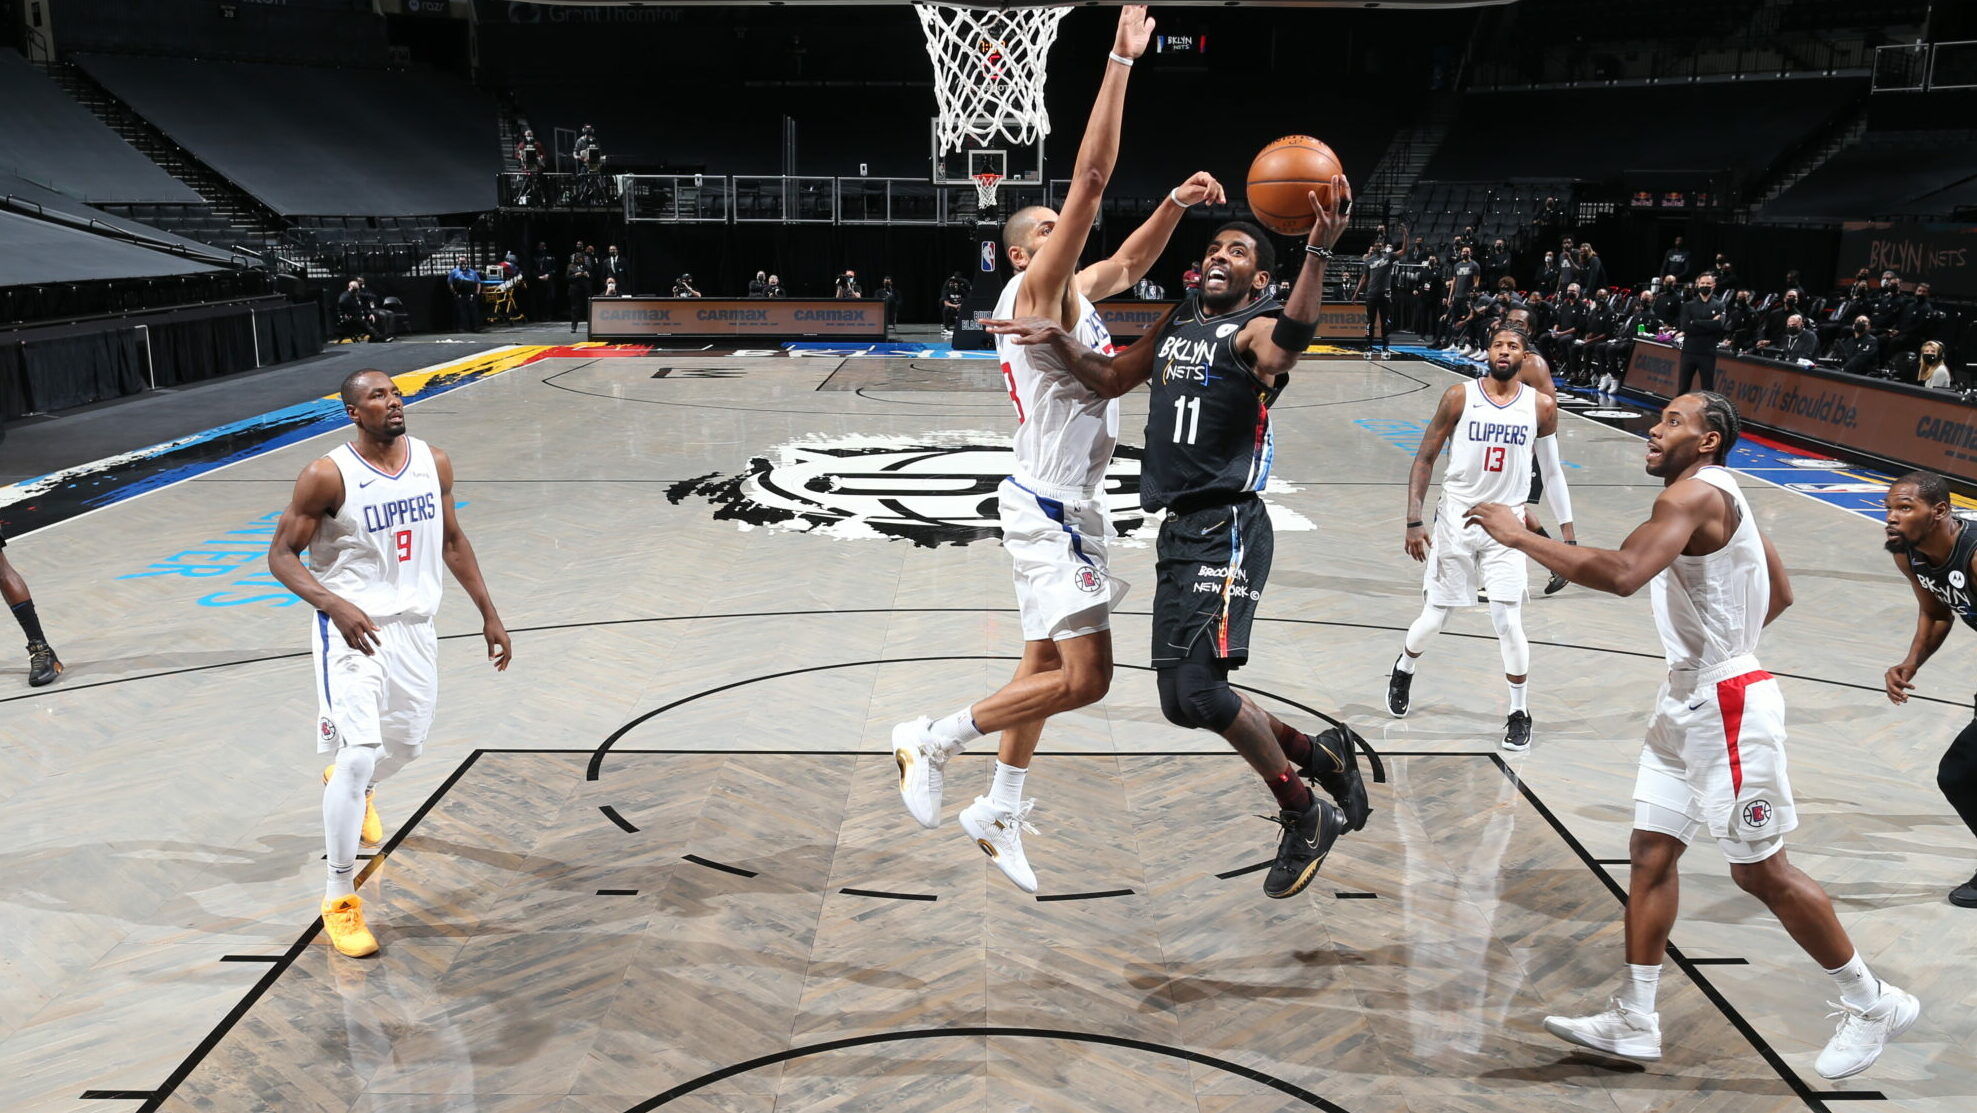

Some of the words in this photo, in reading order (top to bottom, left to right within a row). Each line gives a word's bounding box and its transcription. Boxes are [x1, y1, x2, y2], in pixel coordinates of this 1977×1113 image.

[1167, 35, 1192, 45] BKLYN
[1869, 239, 1923, 274] BKLYN
[1928, 248, 1968, 268] NETS
[1158, 336, 1217, 366] BKLYN
[1166, 364, 1205, 381] NETS
[1737, 382, 1767, 413] way
[1767, 381, 1781, 408] it
[1780, 386, 1837, 422] should
[1172, 395, 1201, 445] 11
[1469, 421, 1528, 446] CLIPPERS
[1484, 447, 1506, 473] 13
[363, 492, 436, 533] CLIPPERS
[395, 529, 412, 562] 9
[1193, 582, 1221, 594] NEW
[1916, 574, 1971, 606] BKYN
